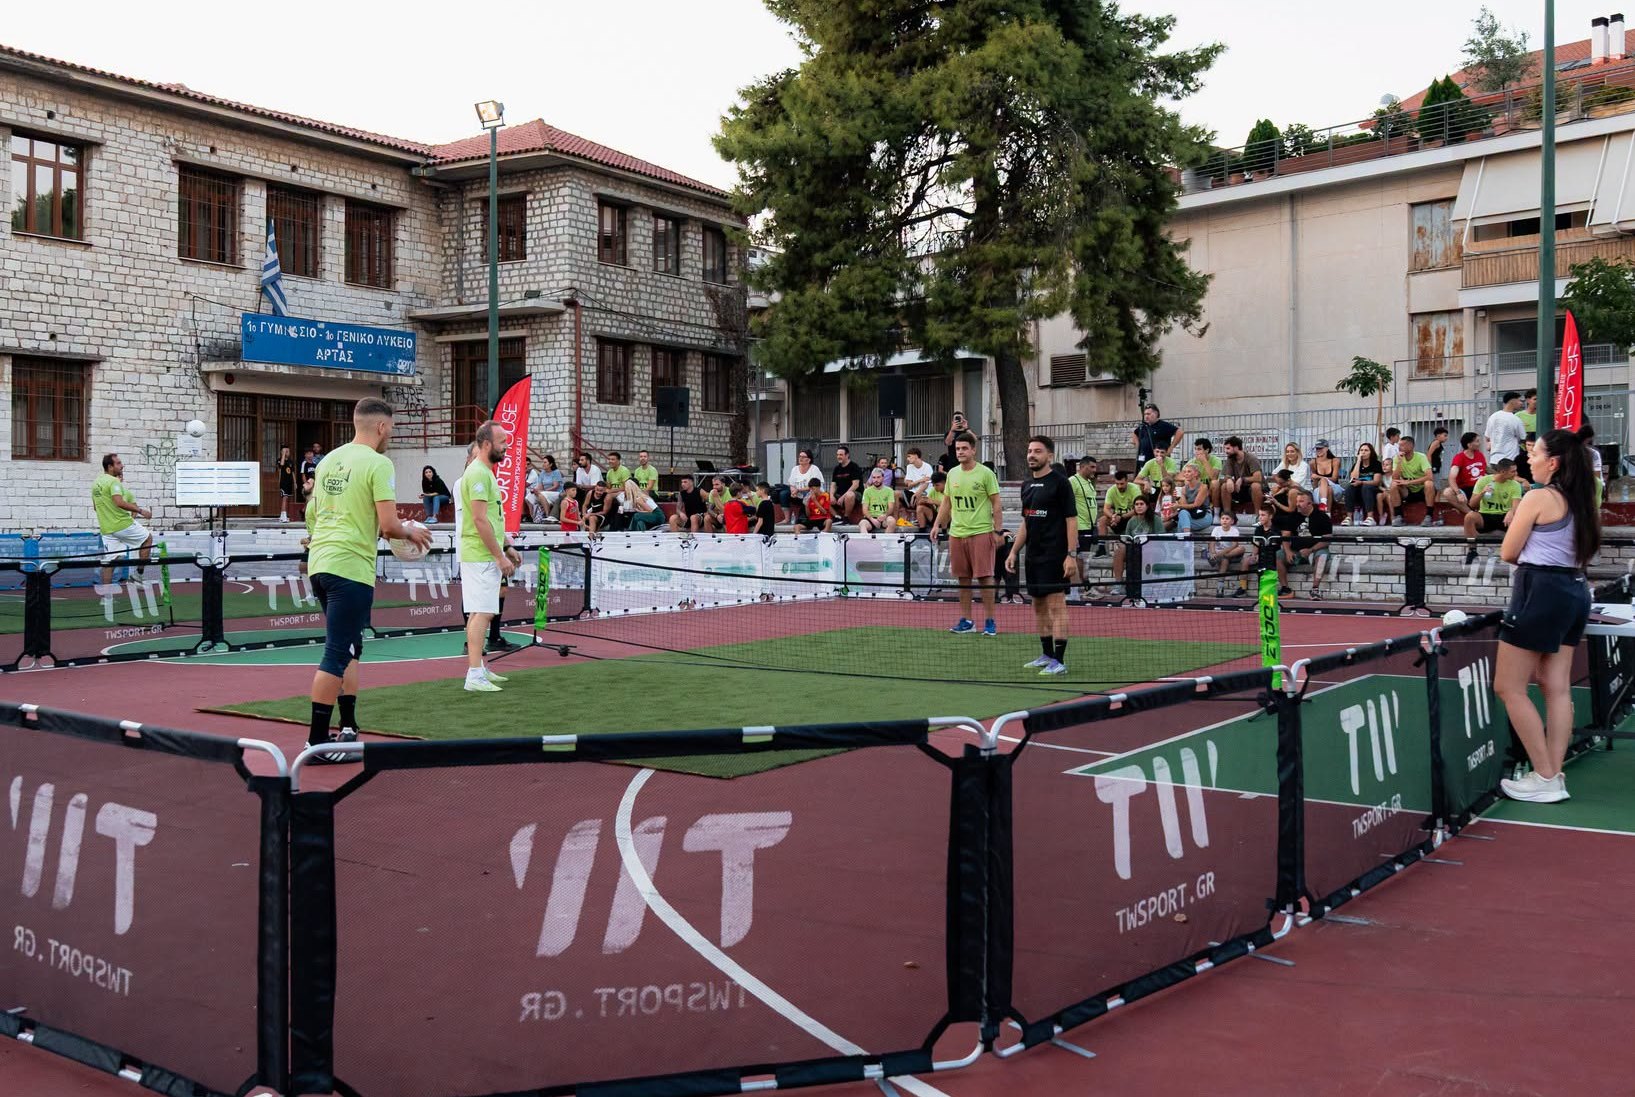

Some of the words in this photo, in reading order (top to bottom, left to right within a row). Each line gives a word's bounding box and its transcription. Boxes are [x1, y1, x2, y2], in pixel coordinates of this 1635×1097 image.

[336, 330, 374, 344] ΓΕΝΙΚΟ
[315, 348, 354, 363] ΑΡΤΑΣ
[270, 613, 320, 627] TWSPORT.GR
[104, 624, 163, 640] TWSPORT.GR
[1466, 738, 1496, 773] TWSPORT.GR
[1351, 793, 1402, 840] TWSPORT.GR
[1115, 871, 1216, 934] TWSPORT.GR
